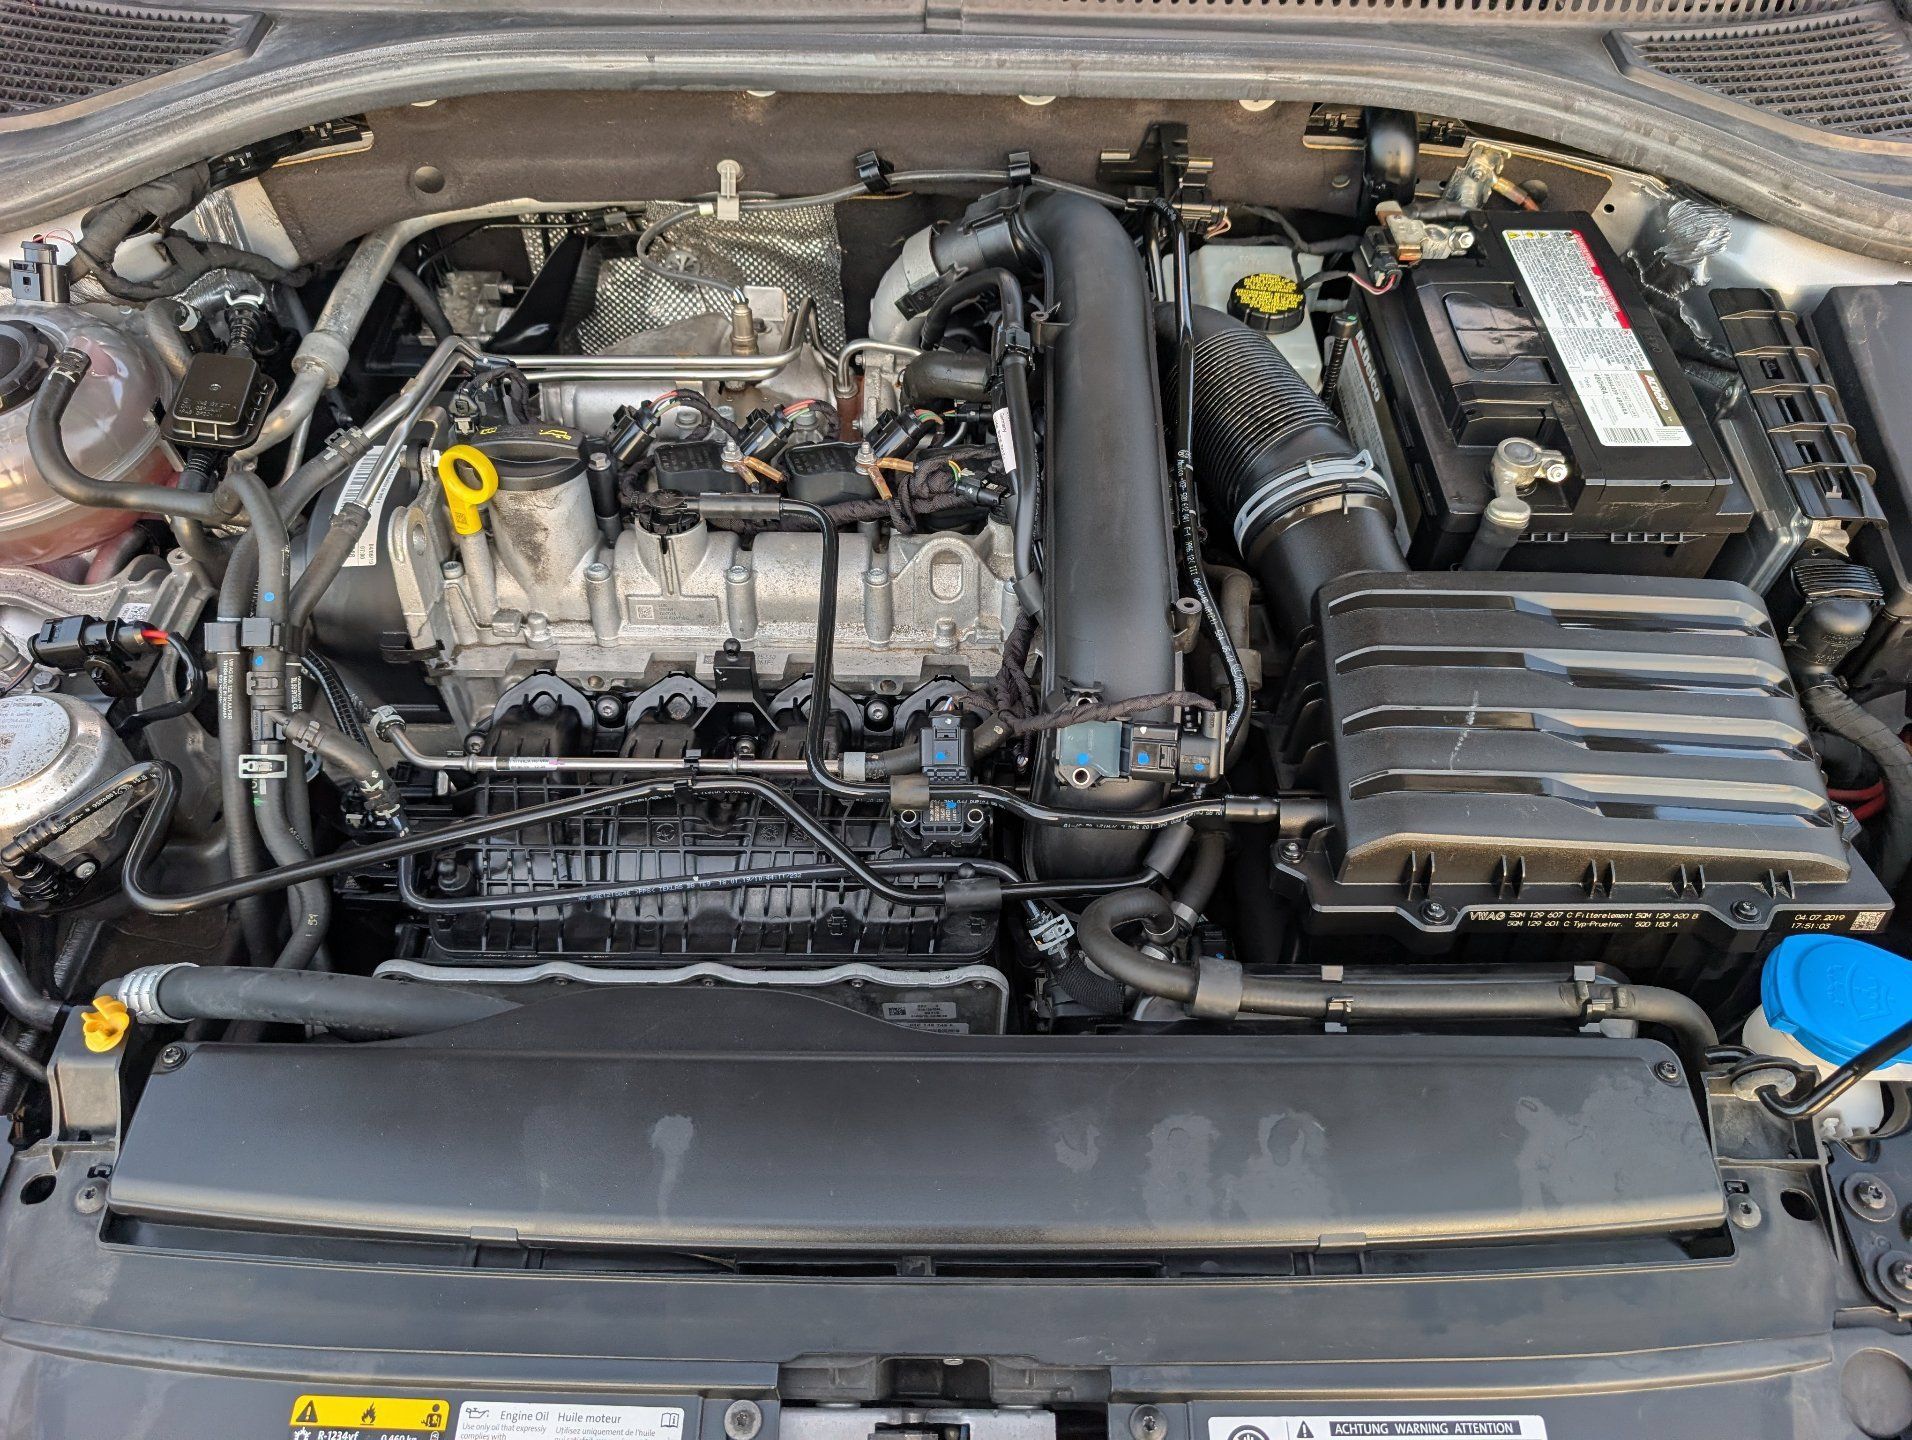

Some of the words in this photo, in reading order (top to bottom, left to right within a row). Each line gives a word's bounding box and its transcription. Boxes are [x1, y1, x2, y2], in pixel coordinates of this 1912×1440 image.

[1355, 329, 1380, 402] ACDelco
[1644, 373, 1669, 411] ACDelco
[500, 1410, 534, 1422] Engine
[535, 1411, 549, 1421] Oil
[558, 1412, 584, 1423] Huile
[585, 1415, 622, 1424] moteur
[318, 1430, 360, 1440] R-1234yf
[476, 1424, 491, 1433] only
[514, 1425, 547, 1434] expressly
[555, 1426, 581, 1434] Utilisez
[582, 1428, 624, 1436] uniquement
[635, 1429, 656, 1437] l'huile
[1335, 1423, 1388, 1435] ACHTUNG
[1394, 1422, 1448, 1435] WARNING
[1454, 1422, 1514, 1434] ATTENTION
